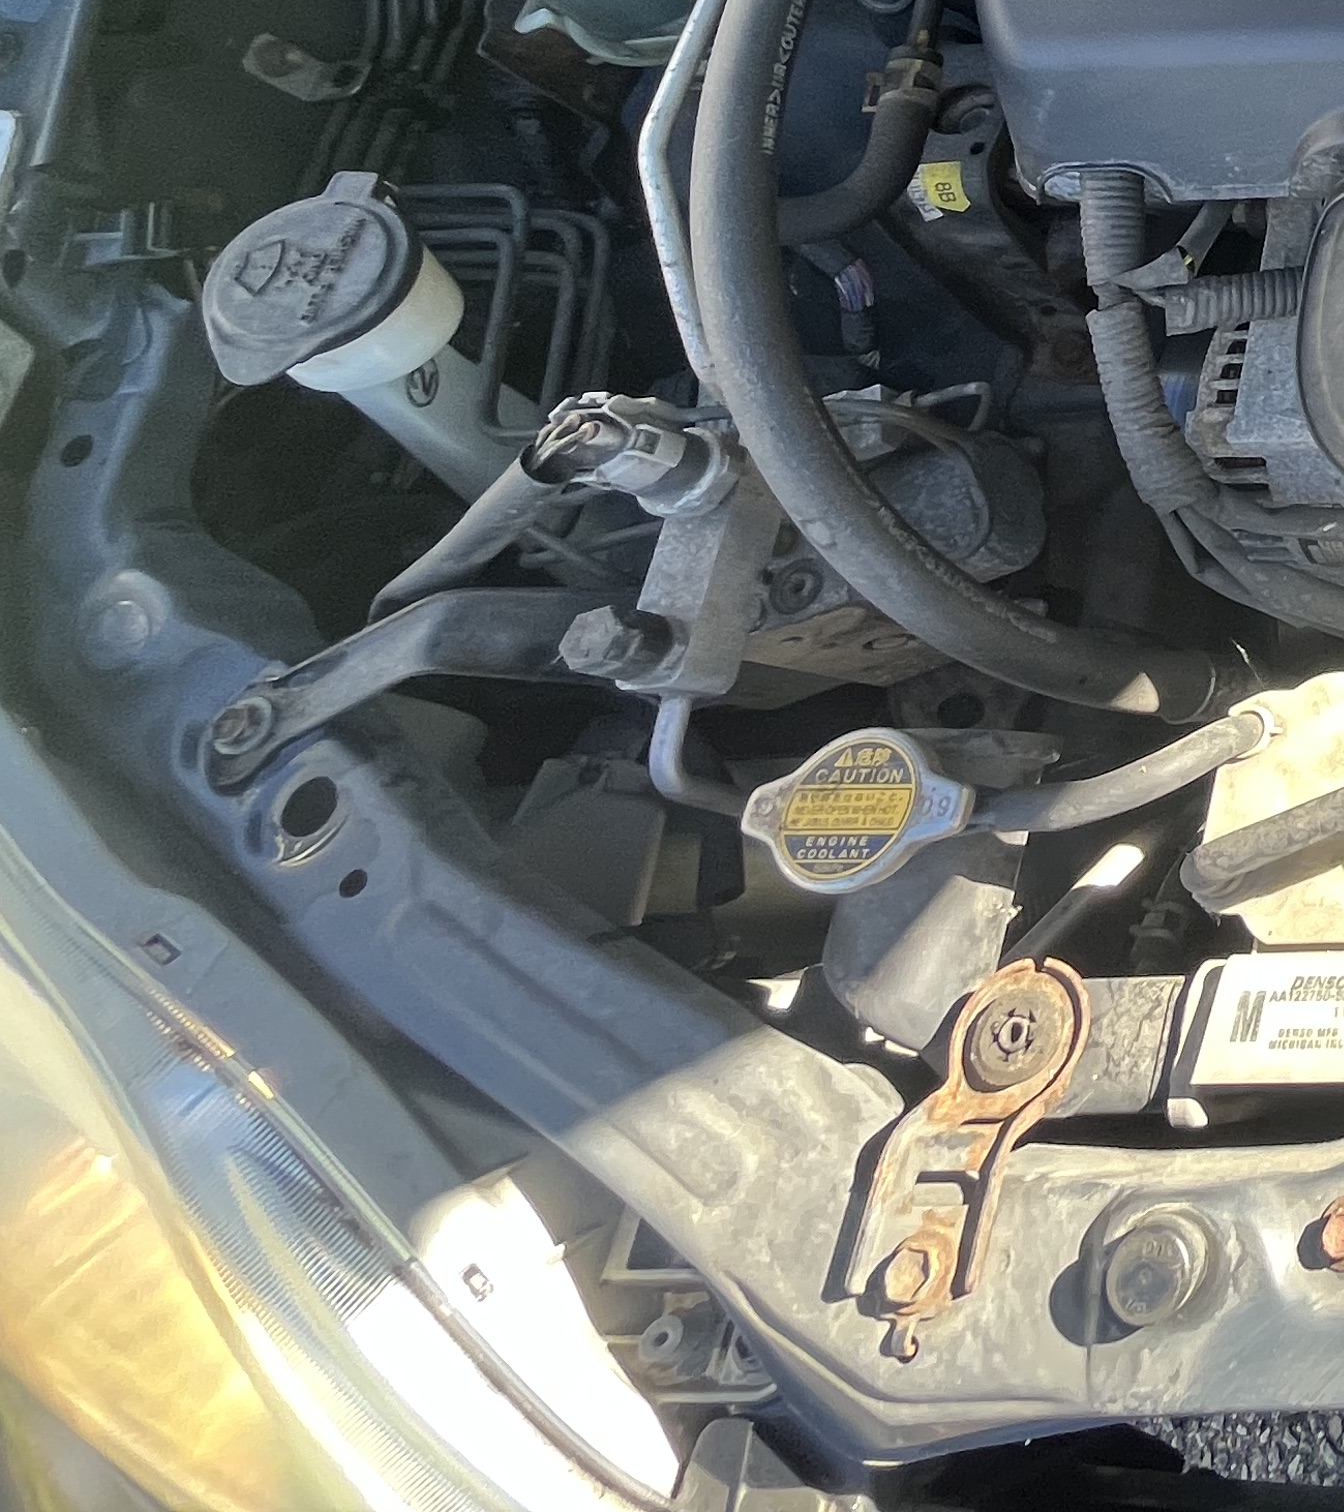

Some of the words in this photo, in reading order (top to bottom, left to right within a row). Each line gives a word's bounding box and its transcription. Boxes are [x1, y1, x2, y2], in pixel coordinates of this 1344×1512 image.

[815, 768, 904, 784] CAUTION
[806, 836, 869, 847] ENGINE
[797, 849, 871, 859] COOLANT
[1230, 991, 1267, 1042] M
